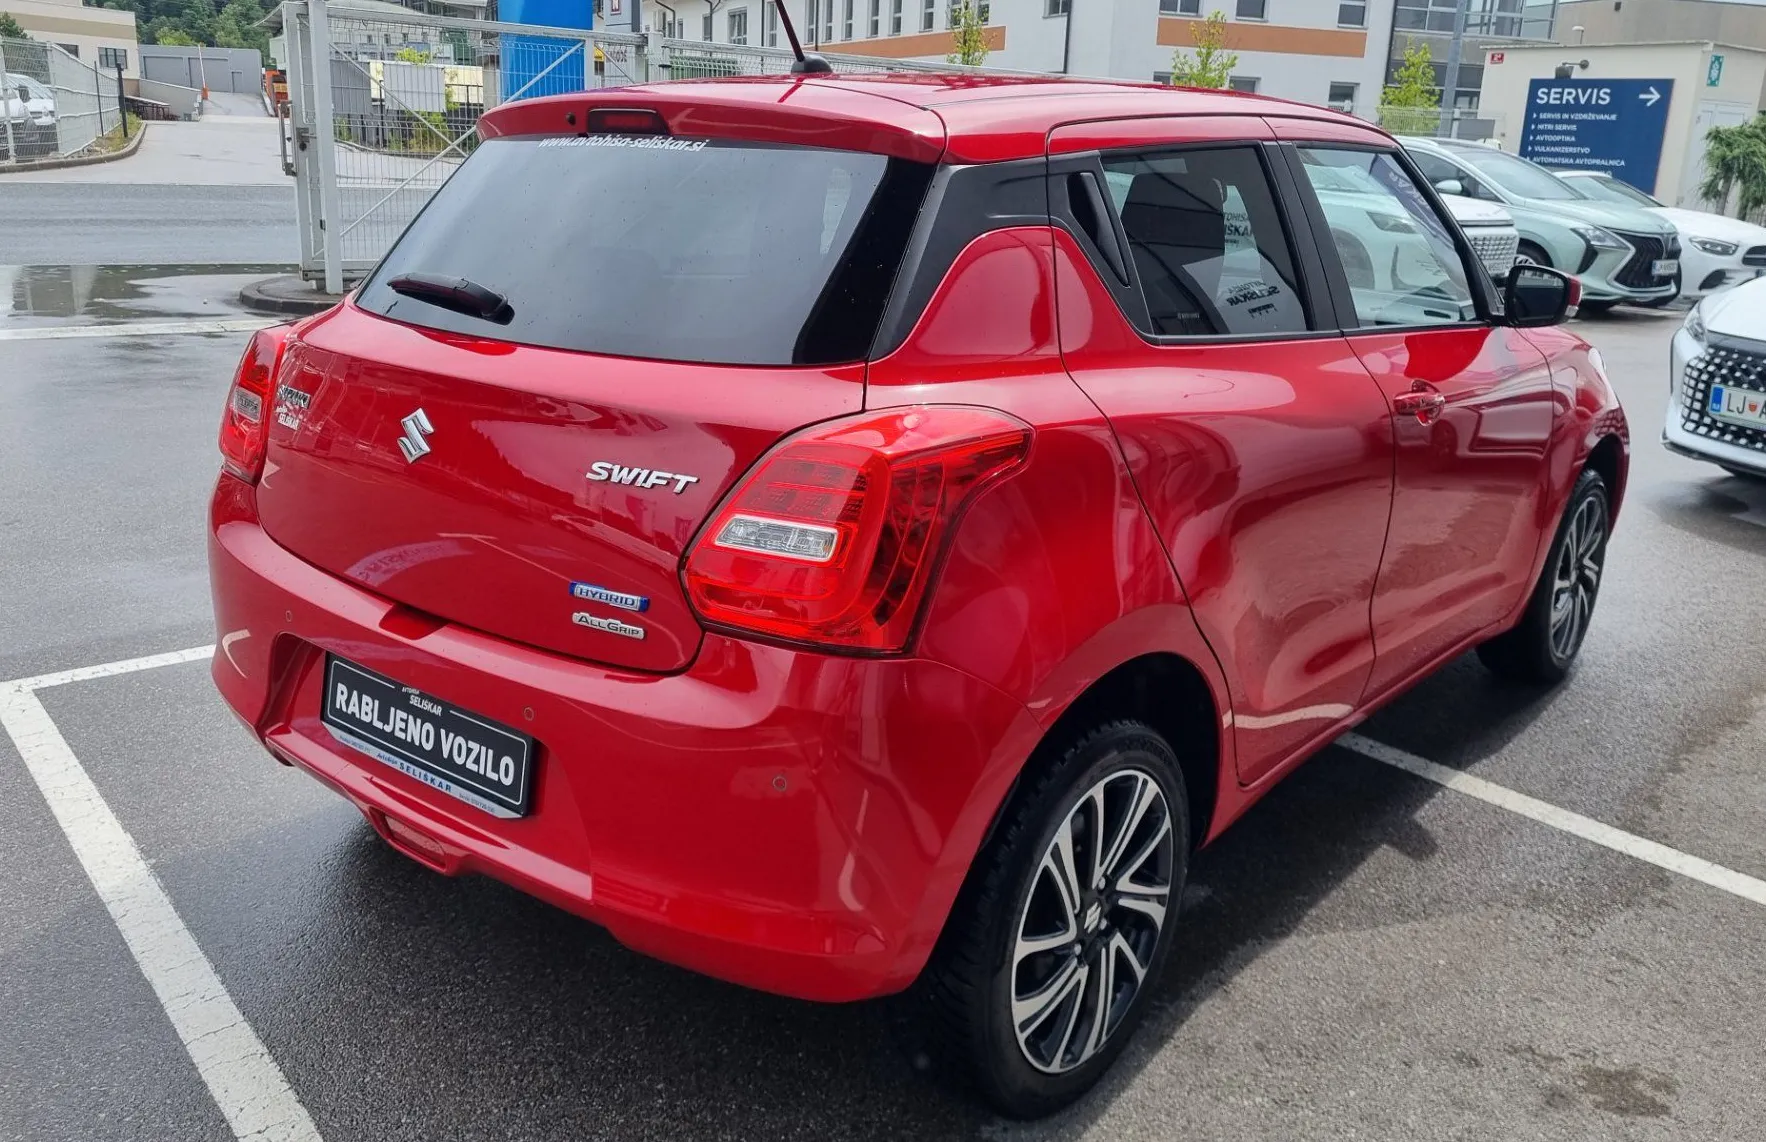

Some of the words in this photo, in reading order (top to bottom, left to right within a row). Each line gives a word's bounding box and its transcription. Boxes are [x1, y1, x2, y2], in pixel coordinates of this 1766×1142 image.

[1536, 87, 1611, 105] SERVIS
[1539, 112, 1561, 120] SERVIS
[1562, 112, 1569, 120] IN
[1570, 111, 1618, 121] VZDRŽEVANJE
[539, 134, 710, 152] www.avtohisa-seliskar.si
[1535, 134, 1576, 142] AVTOOPTIKA
[1533, 145, 1591, 154] VULKANIZERSTVO
[1574, 158, 1626, 167] AVTOPRALNICA
[1727, 392, 1747, 415] LJ
[585, 461, 699, 494] SWIFT
[579, 587, 636, 608] HYBRID
[335, 682, 435, 751] RABLJENO
[439, 728, 515, 786] VOZILO
[399, 762, 452, 792] SELIŠKAR
